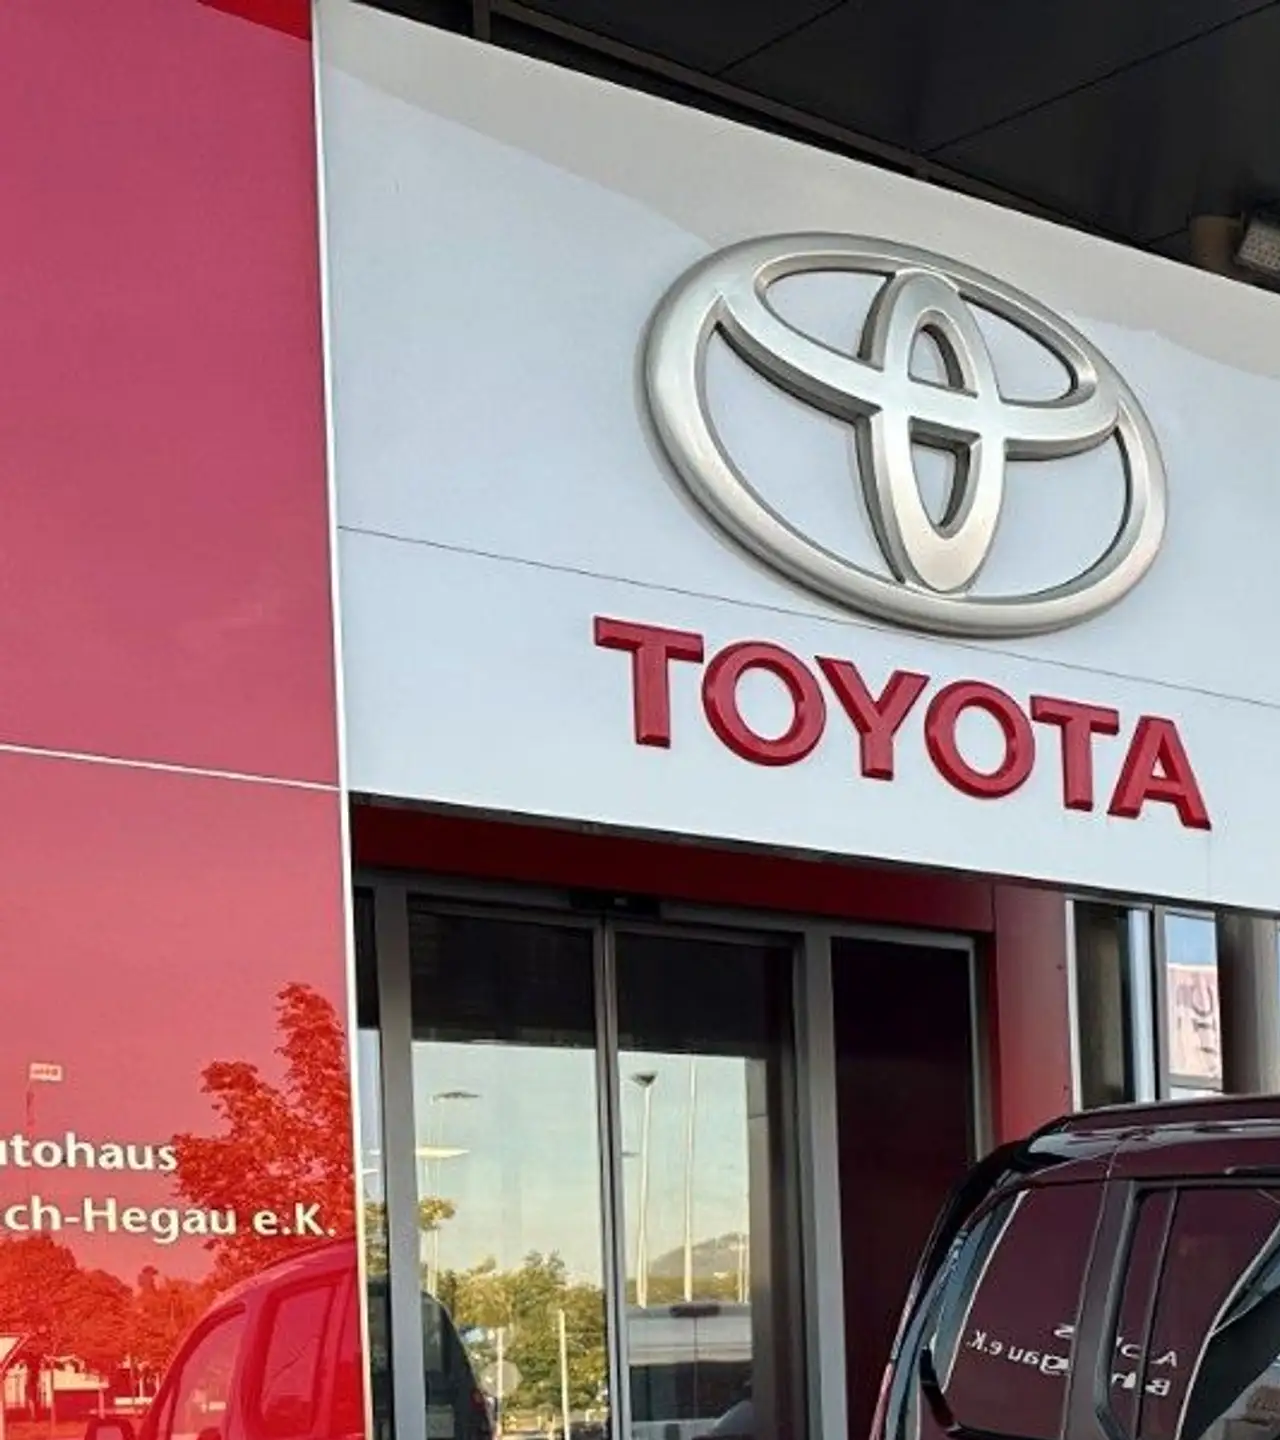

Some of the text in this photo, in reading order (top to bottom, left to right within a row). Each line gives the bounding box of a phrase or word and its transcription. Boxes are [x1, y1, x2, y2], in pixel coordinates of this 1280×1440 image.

[594, 615, 1212, 831] TOYOTA
[0, 1132, 179, 1171] tohaus
[253, 1202, 337, 1237] e.K.
